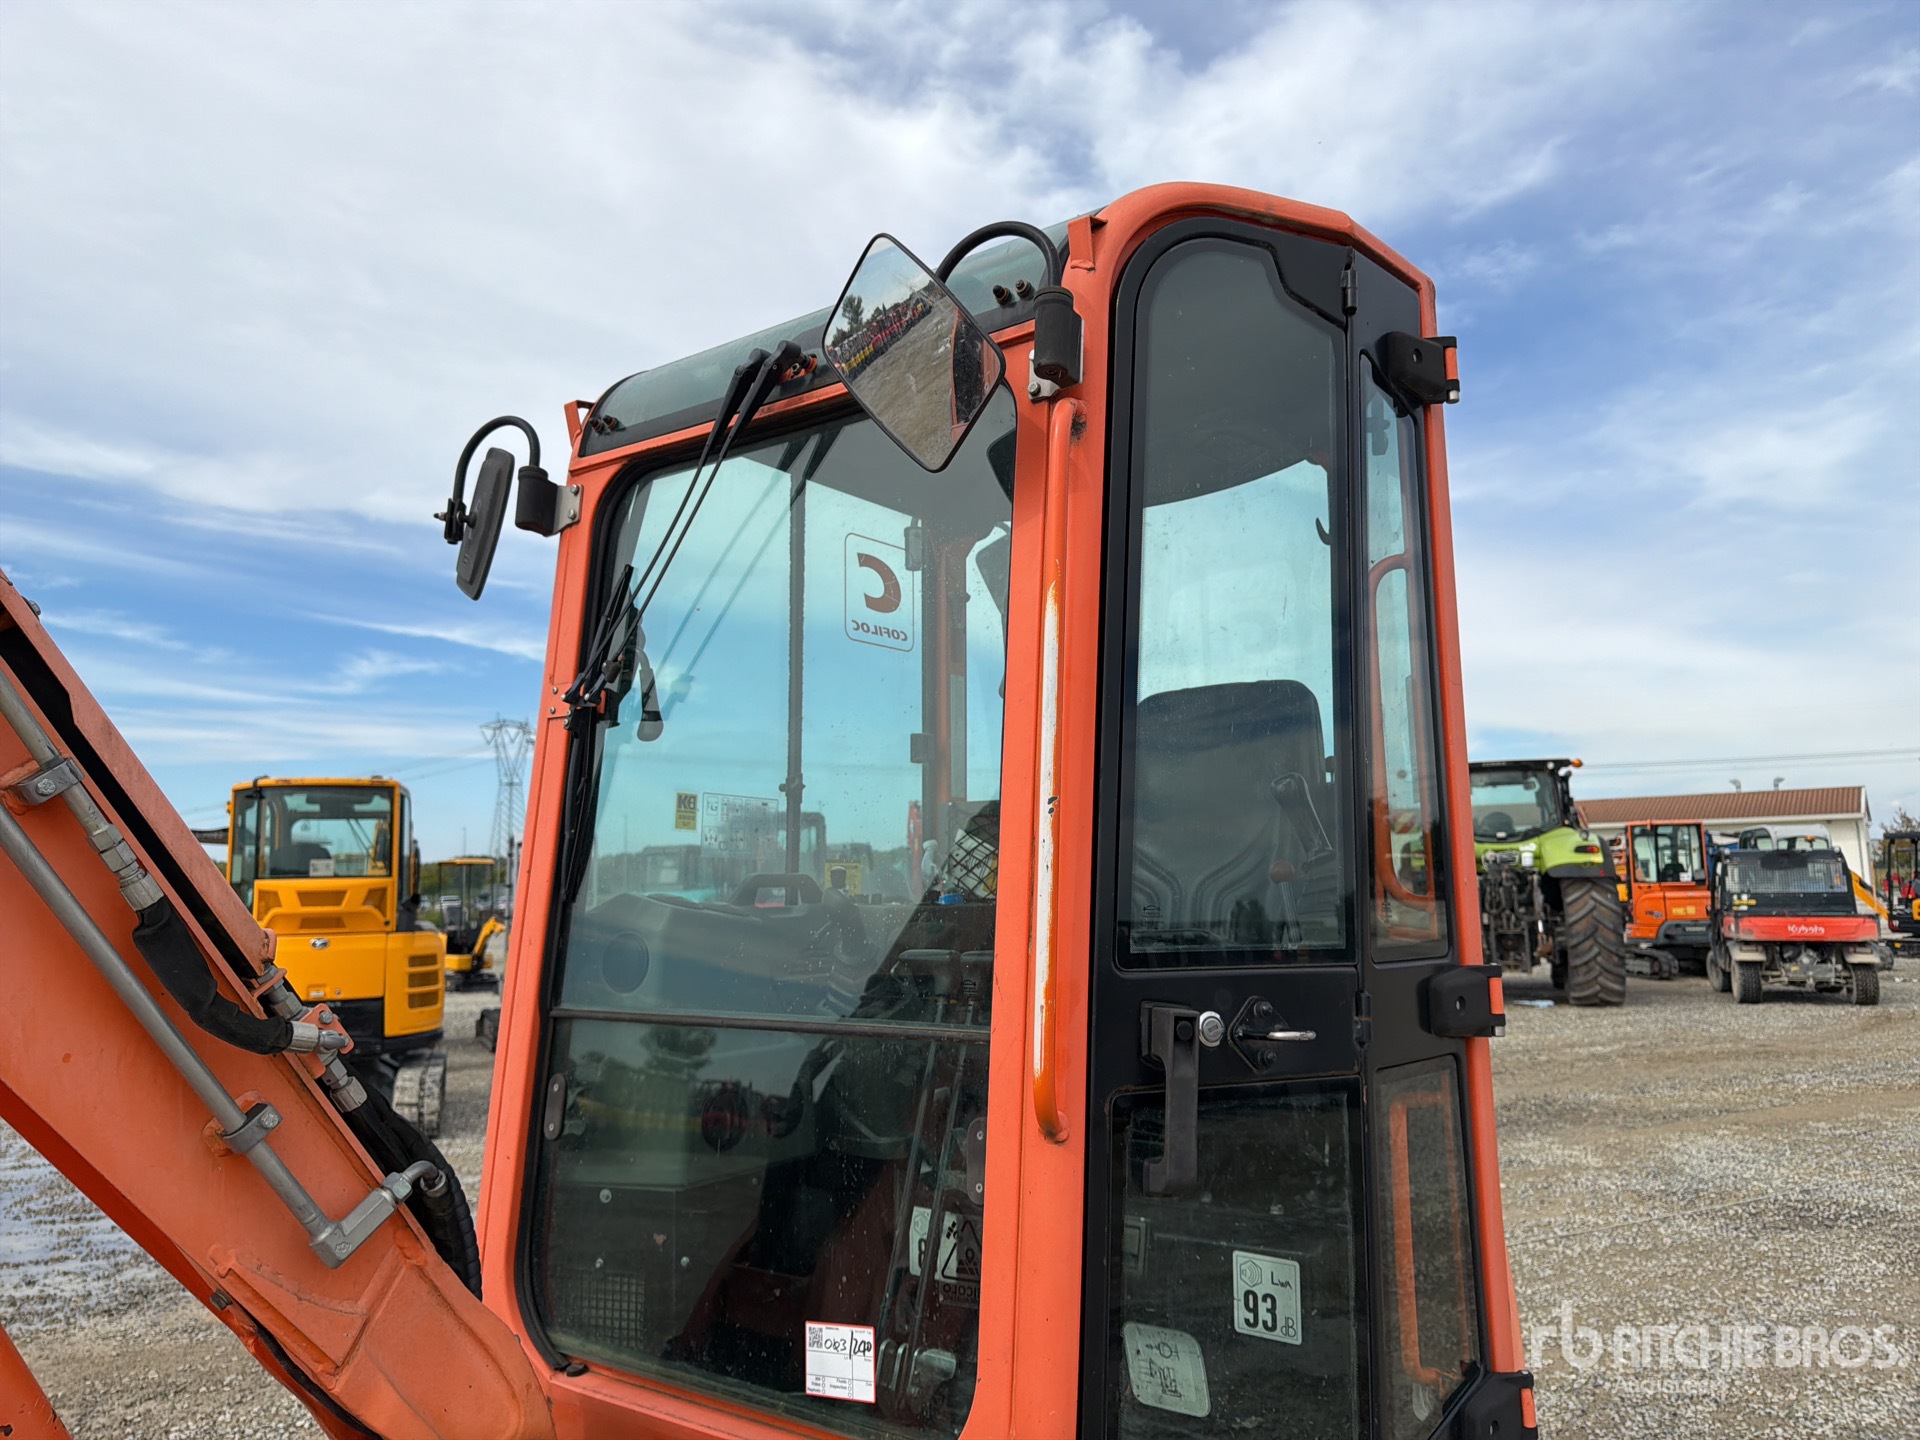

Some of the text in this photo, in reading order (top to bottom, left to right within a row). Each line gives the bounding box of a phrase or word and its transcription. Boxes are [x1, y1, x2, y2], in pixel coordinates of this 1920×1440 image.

[1787, 924, 1825, 936] Kubota
[1243, 1289, 1278, 1333] 93
[1280, 1316, 1297, 1338] dB
